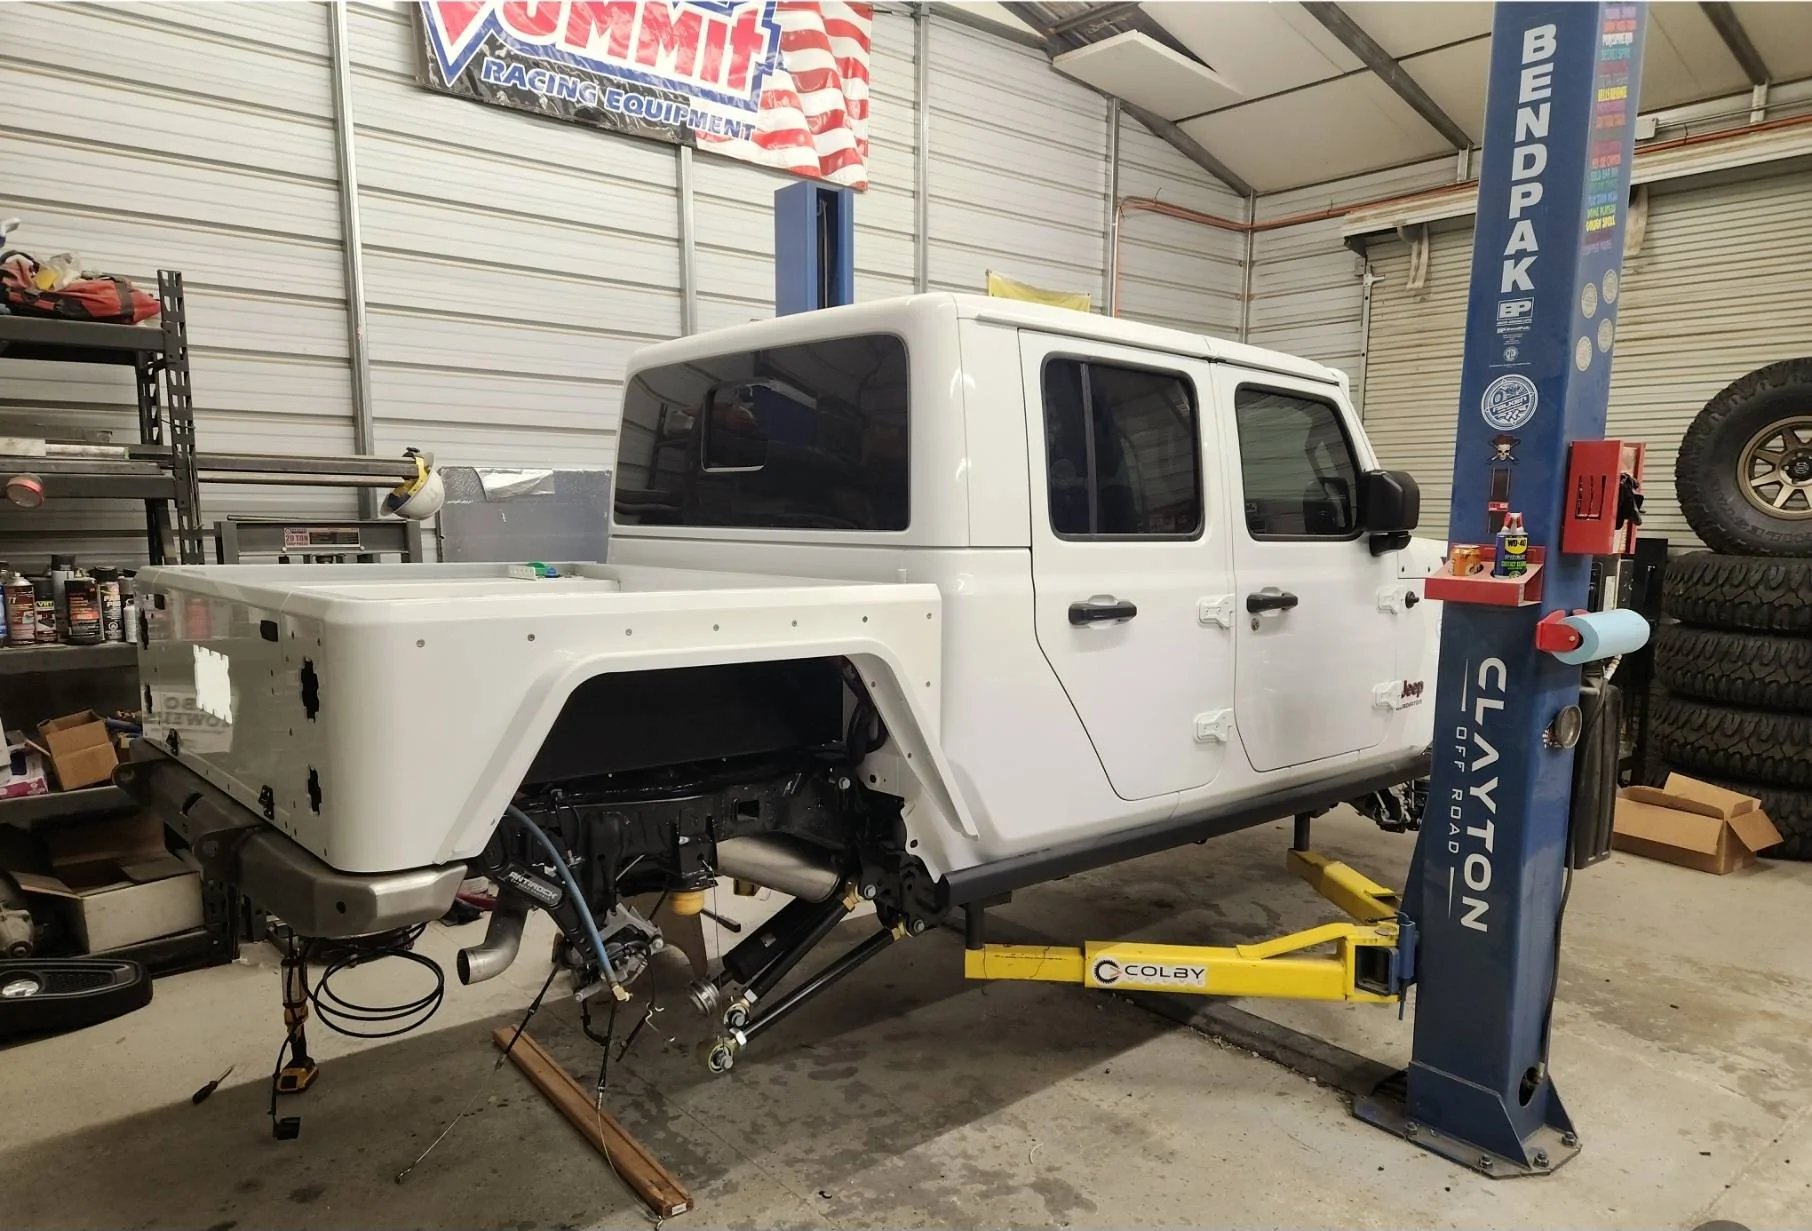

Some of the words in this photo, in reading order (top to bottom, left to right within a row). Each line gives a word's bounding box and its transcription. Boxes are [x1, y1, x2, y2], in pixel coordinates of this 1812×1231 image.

[481, 57, 597, 106] RACING
[604, 88, 757, 142] EQUIPMENT
[1500, 23, 1557, 293] BENDPAK
[1507, 539, 1526, 547] WD-40
[1401, 680, 1423, 699] Jeep
[1454, 726, 1467, 772] OFF
[1448, 788, 1463, 854] ROAD
[1461, 657, 1507, 932] CLAYTON
[1125, 965, 1205, 979] COLBY
